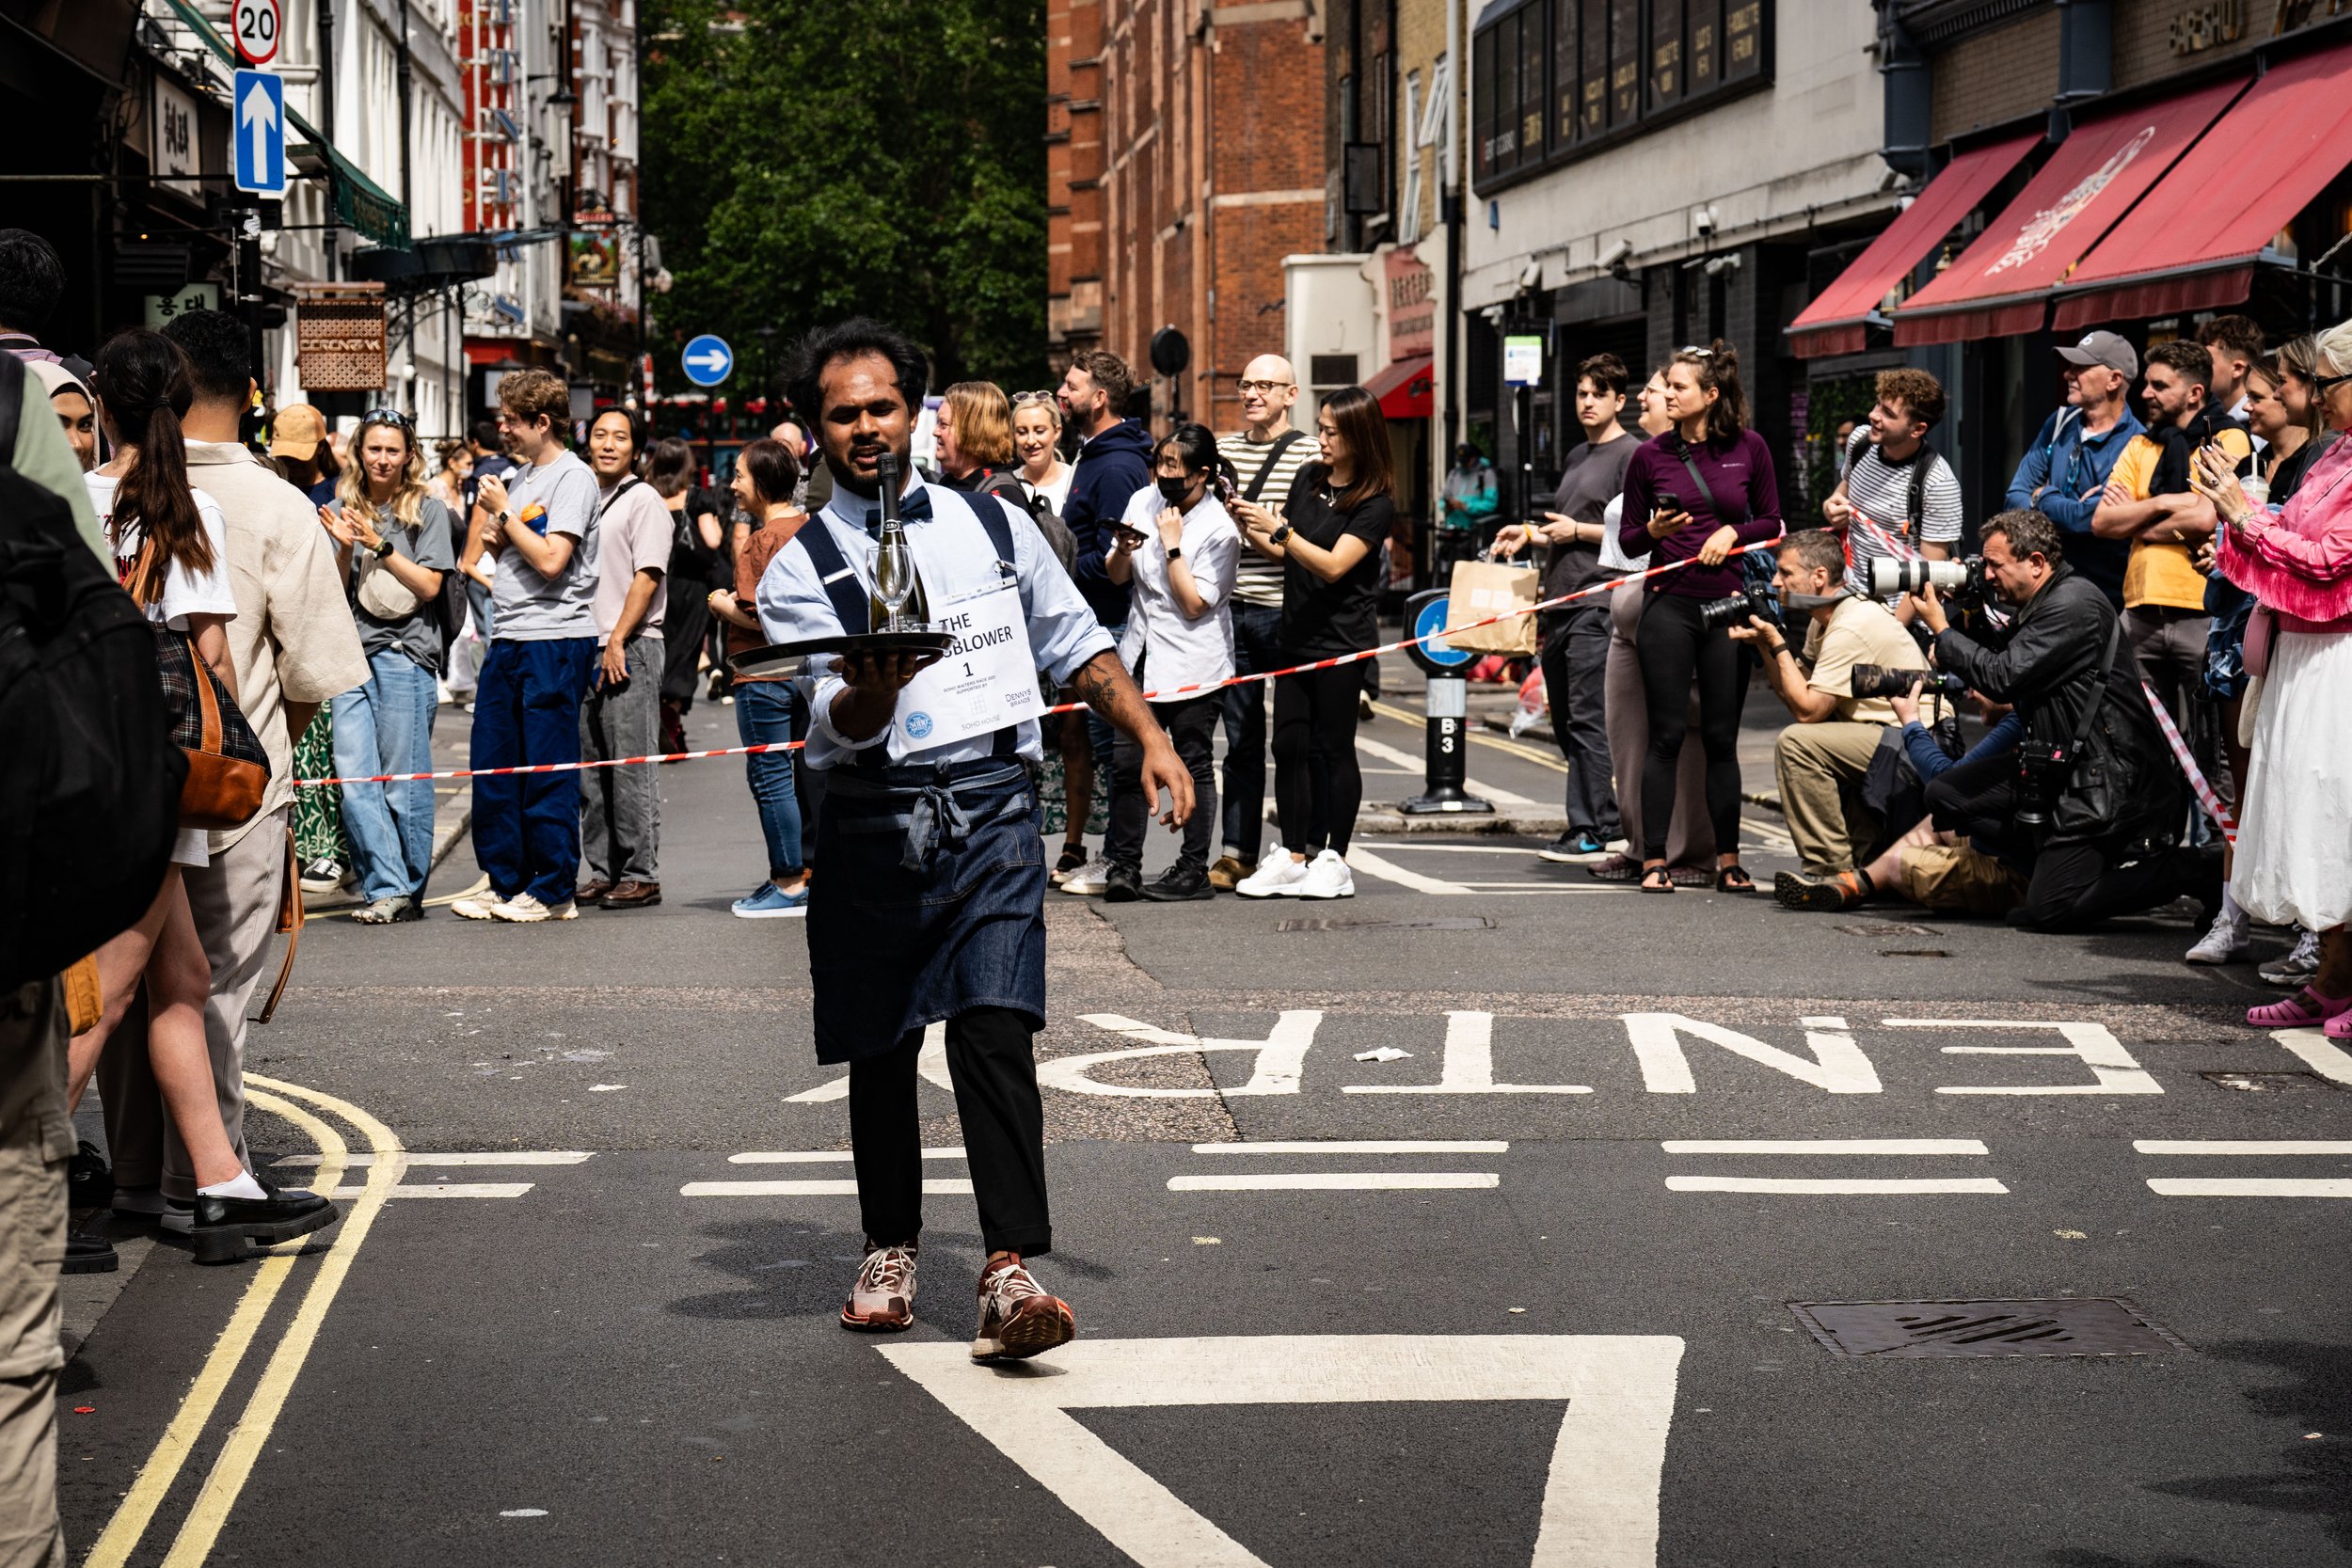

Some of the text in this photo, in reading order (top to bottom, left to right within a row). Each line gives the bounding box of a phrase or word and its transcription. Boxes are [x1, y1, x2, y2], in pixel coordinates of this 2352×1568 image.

[241, 7, 274, 40] 20
[939, 612, 972, 631] THE
[963, 662, 974, 677] 1
[956, 685, 981, 694] SUPPORTED
[1010, 697, 1031, 707] BRANDS
[961, 715, 1001, 731] SOHO HOUSE
[1441, 718, 1455, 734] B
[1441, 736, 1454, 753] 3
